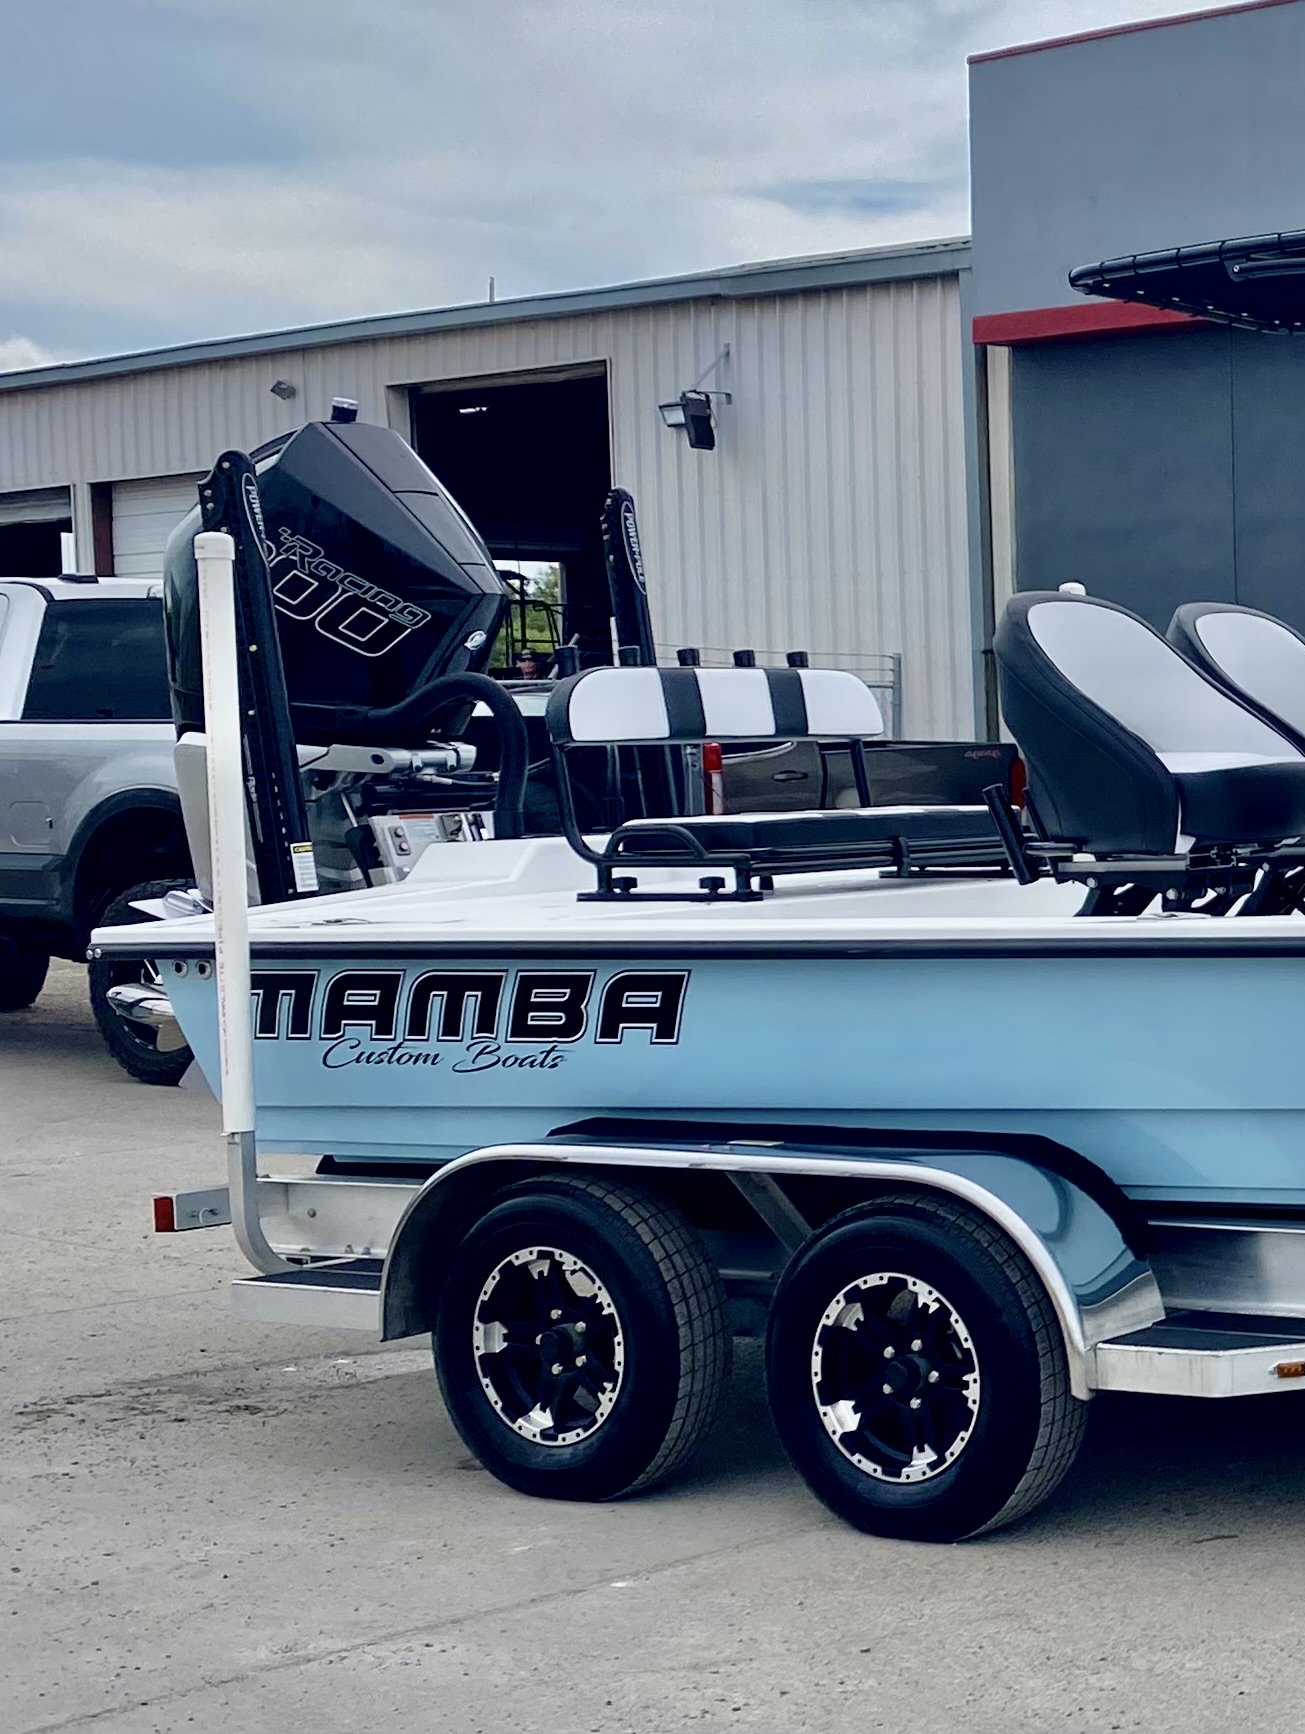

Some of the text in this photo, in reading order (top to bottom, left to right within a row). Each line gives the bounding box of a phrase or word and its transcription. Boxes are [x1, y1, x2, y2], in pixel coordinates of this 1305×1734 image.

[264, 539, 413, 657] 00
[279, 534, 432, 629] Racing
[250, 967, 692, 1045] MAMBA
[322, 1037, 568, 1073] Custom Boats
